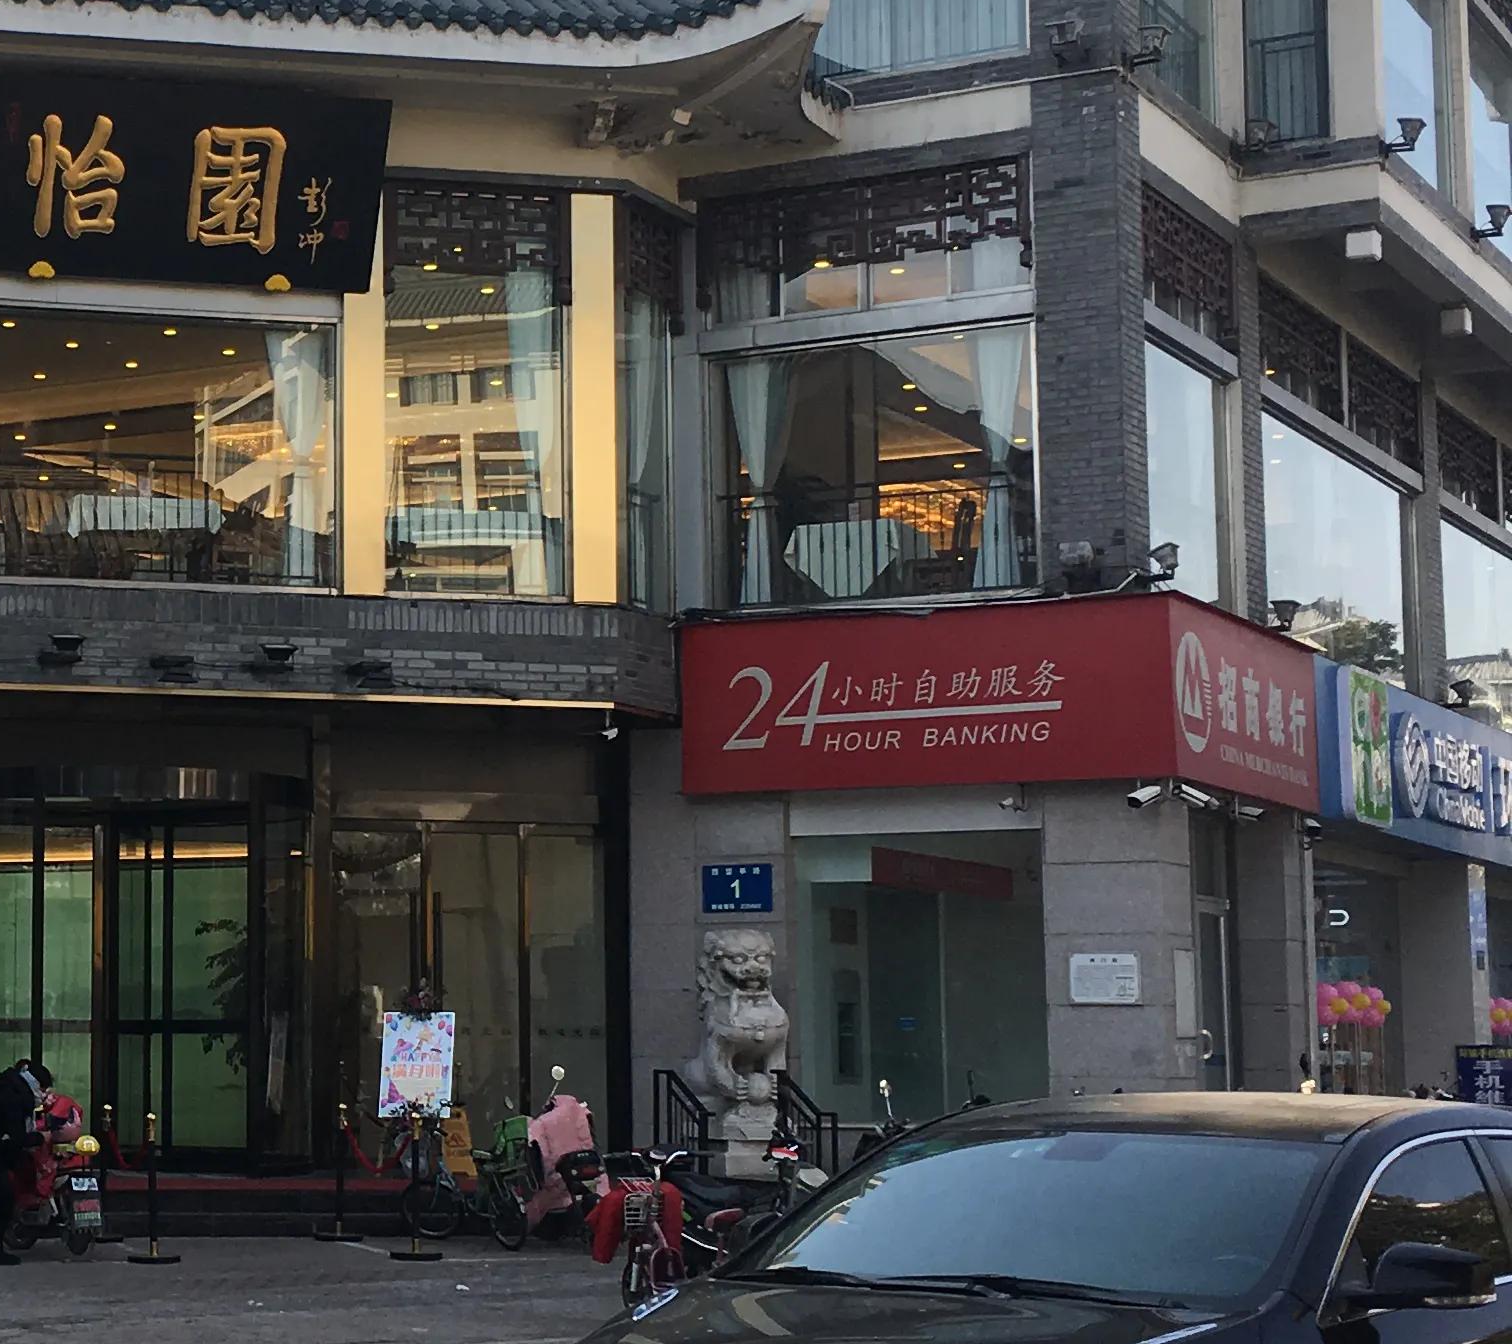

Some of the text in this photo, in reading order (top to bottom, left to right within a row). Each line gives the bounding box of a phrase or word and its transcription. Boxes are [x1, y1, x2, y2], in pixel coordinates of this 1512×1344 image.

[722, 659, 1065, 750] 24 小时自助服务
[1217, 656, 1307, 757] 招商银行
[824, 721, 1052, 753] HOUR BANKING
[1432, 731, 1484, 794] 中国移动
[730, 879, 740, 899] 1
